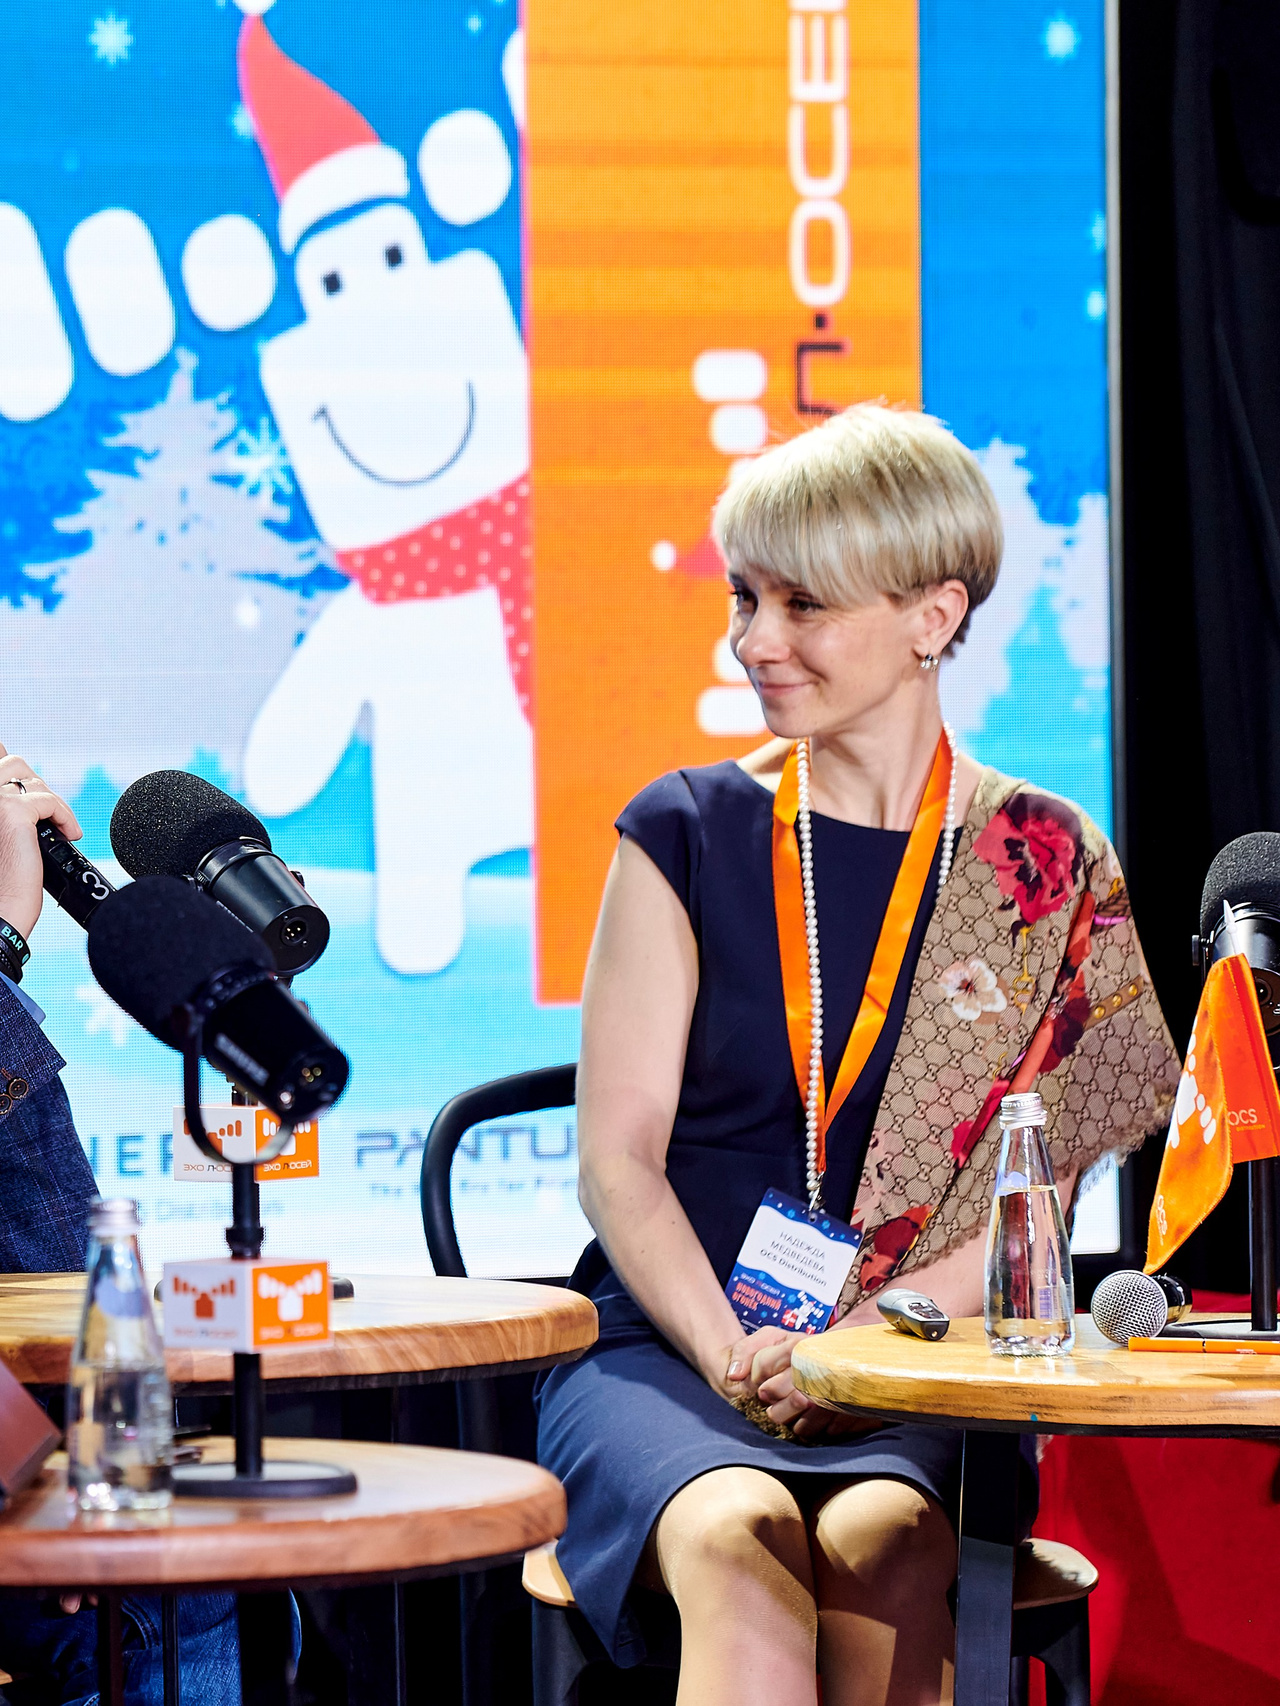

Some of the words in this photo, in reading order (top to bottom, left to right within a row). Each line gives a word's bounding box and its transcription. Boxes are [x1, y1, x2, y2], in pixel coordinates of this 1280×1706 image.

[1, 926, 24, 951] BAR
[1227, 1108, 1258, 1127] OCS
[183, 1163, 205, 1172] ЭХО
[263, 1163, 281, 1172] ЭХО
[778, 1257, 828, 1287] Distribution
